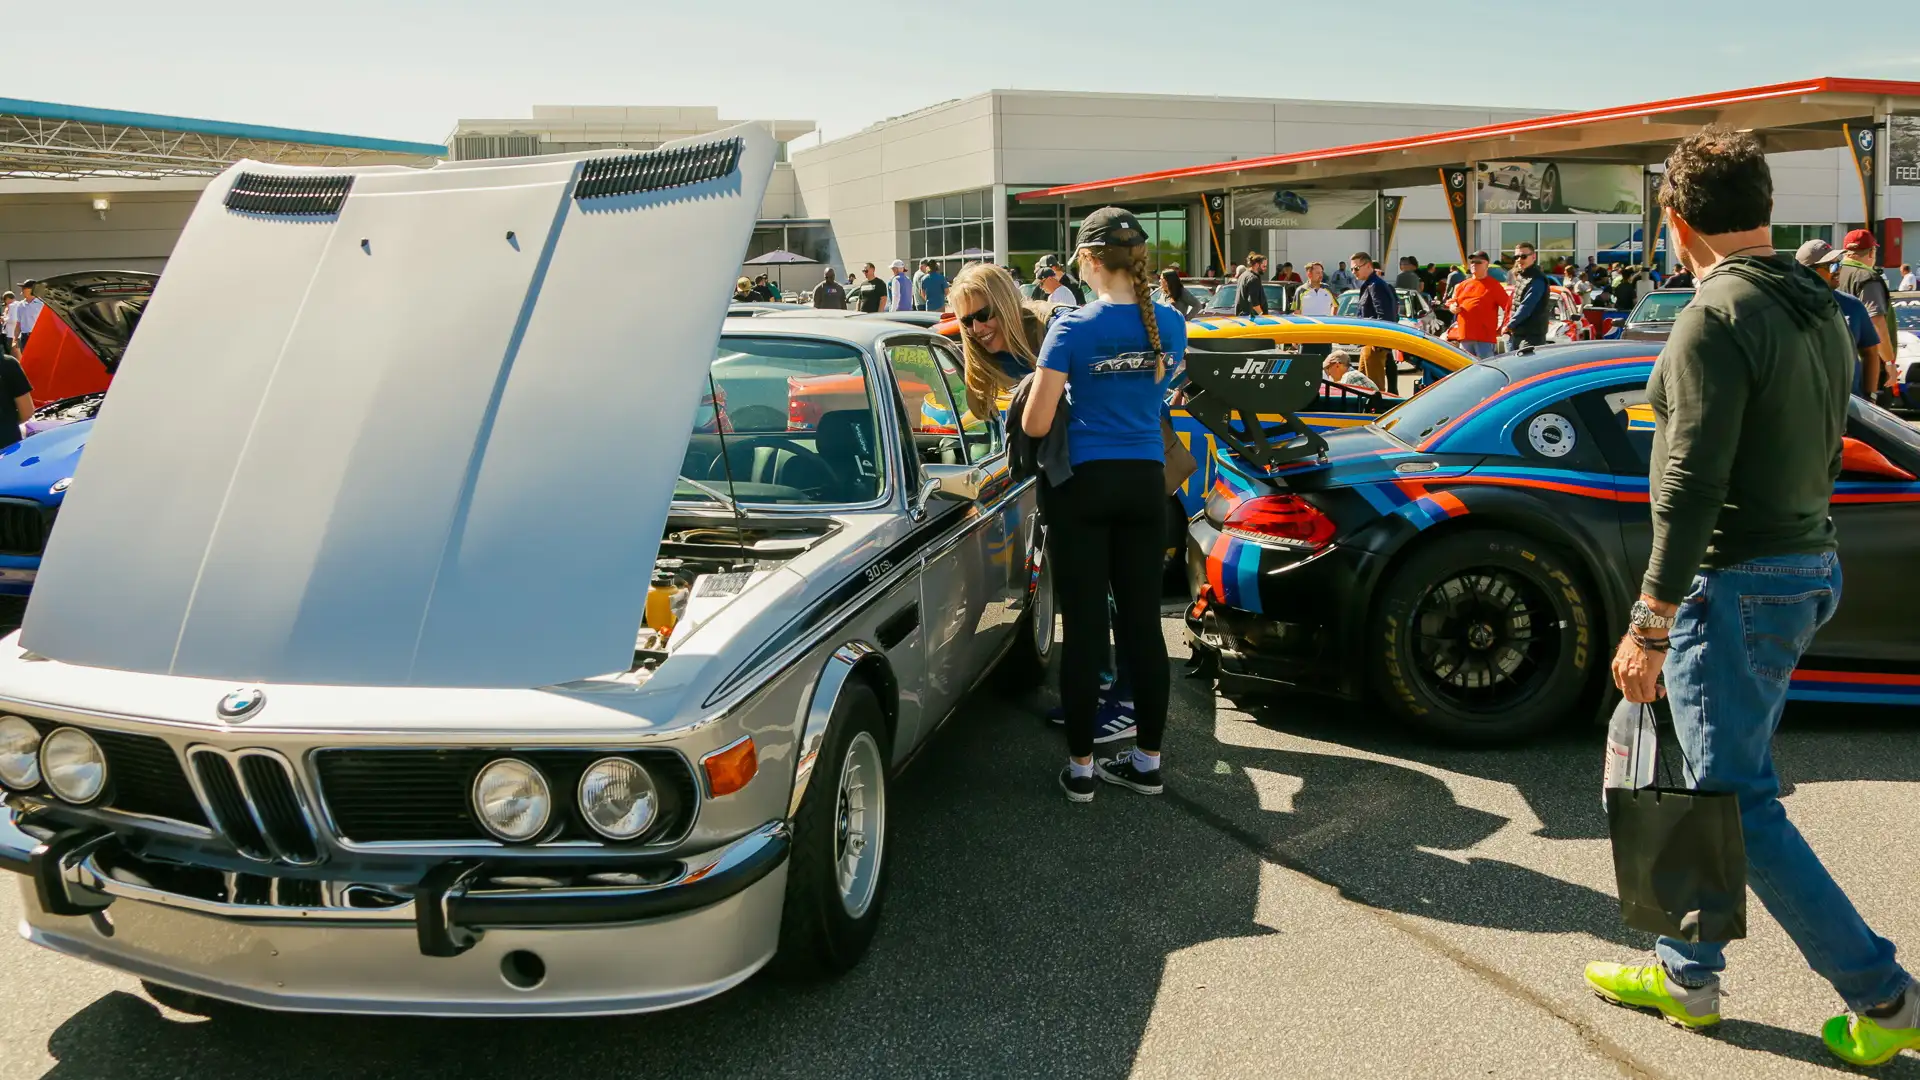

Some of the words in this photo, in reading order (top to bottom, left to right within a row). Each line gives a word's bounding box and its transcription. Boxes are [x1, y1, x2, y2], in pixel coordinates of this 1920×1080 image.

[1896, 166, 1920, 180] FEEL
[1485, 200, 1497, 210] TO
[1499, 199, 1532, 210] CATCH
[1239, 217, 1263, 227] YOUR
[879, 560, 893, 573] CSL
[1383, 614, 1429, 716] PIRELLI
